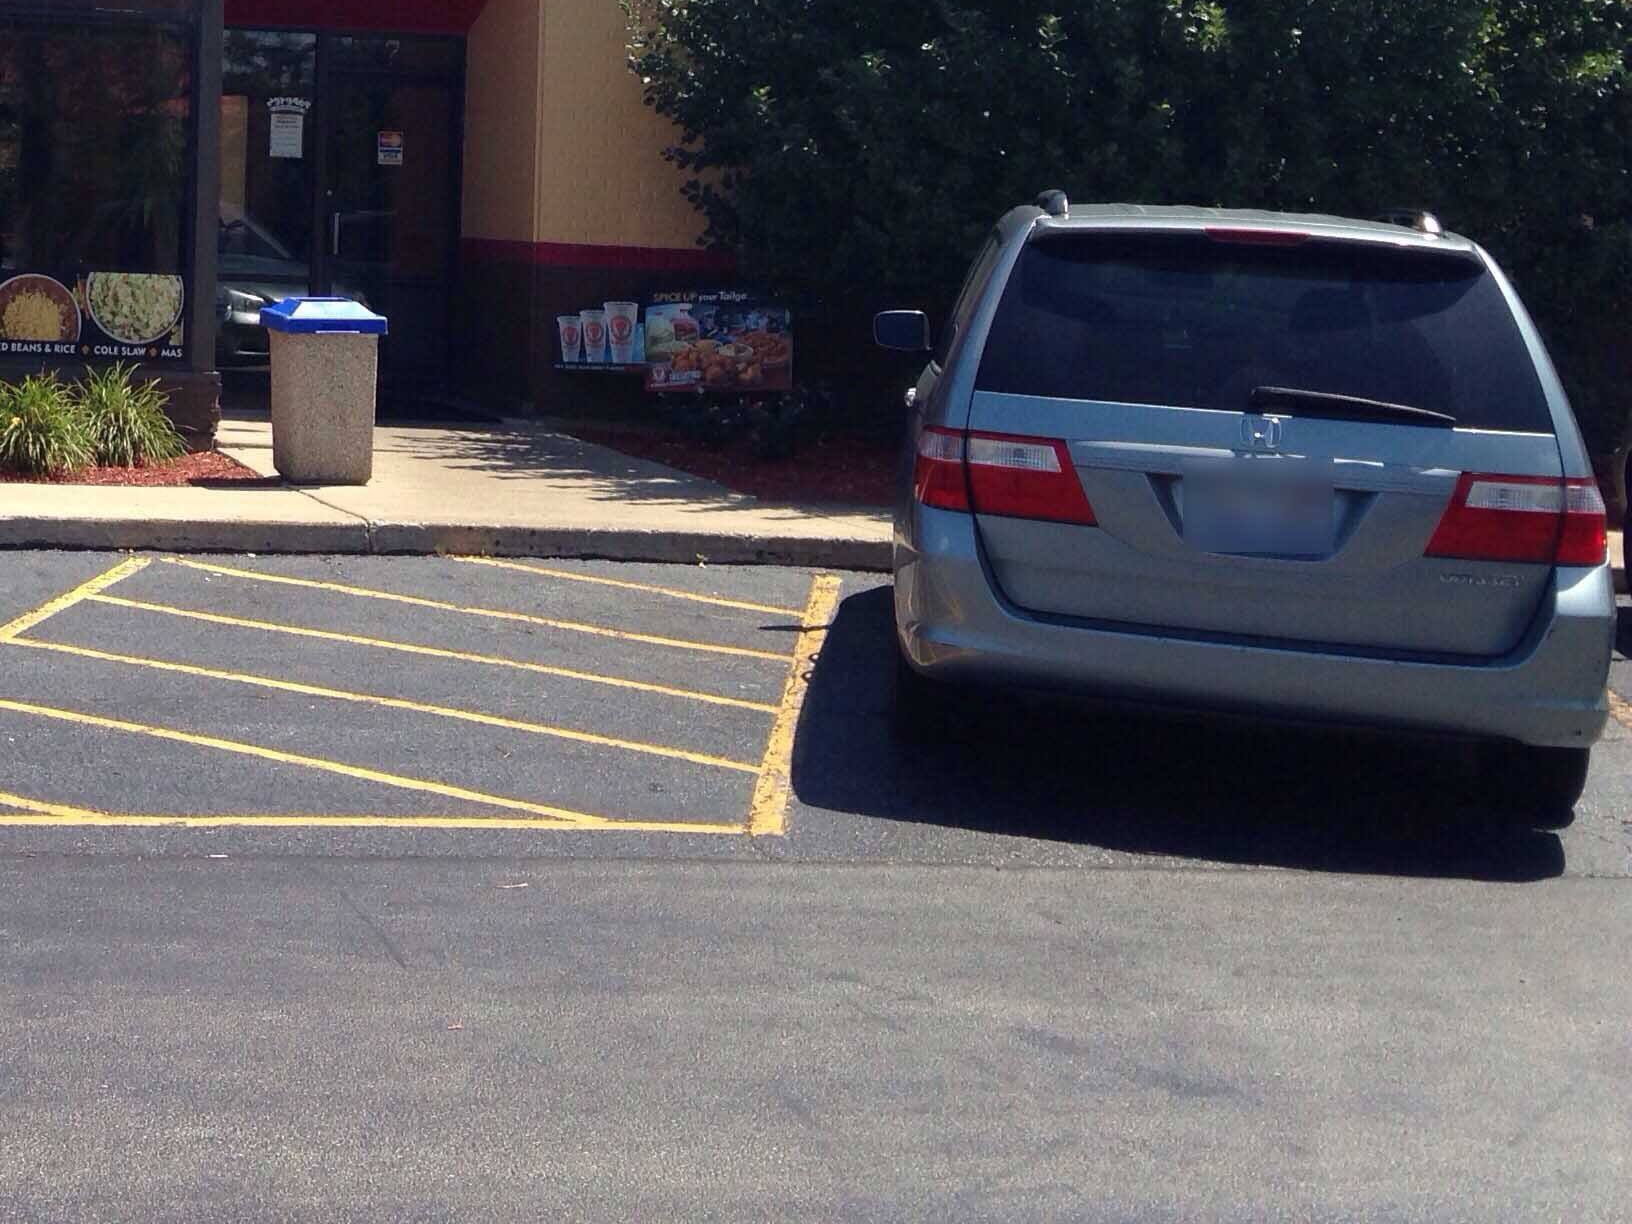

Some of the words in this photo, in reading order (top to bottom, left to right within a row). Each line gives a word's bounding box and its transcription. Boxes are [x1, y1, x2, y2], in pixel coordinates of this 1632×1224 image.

[11, 343, 42, 353] BEANS
[44, 344, 51, 353] &
[54, 344, 76, 354] RICE
[94, 345, 119, 355] COLE
[121, 346, 146, 356] SLAW
